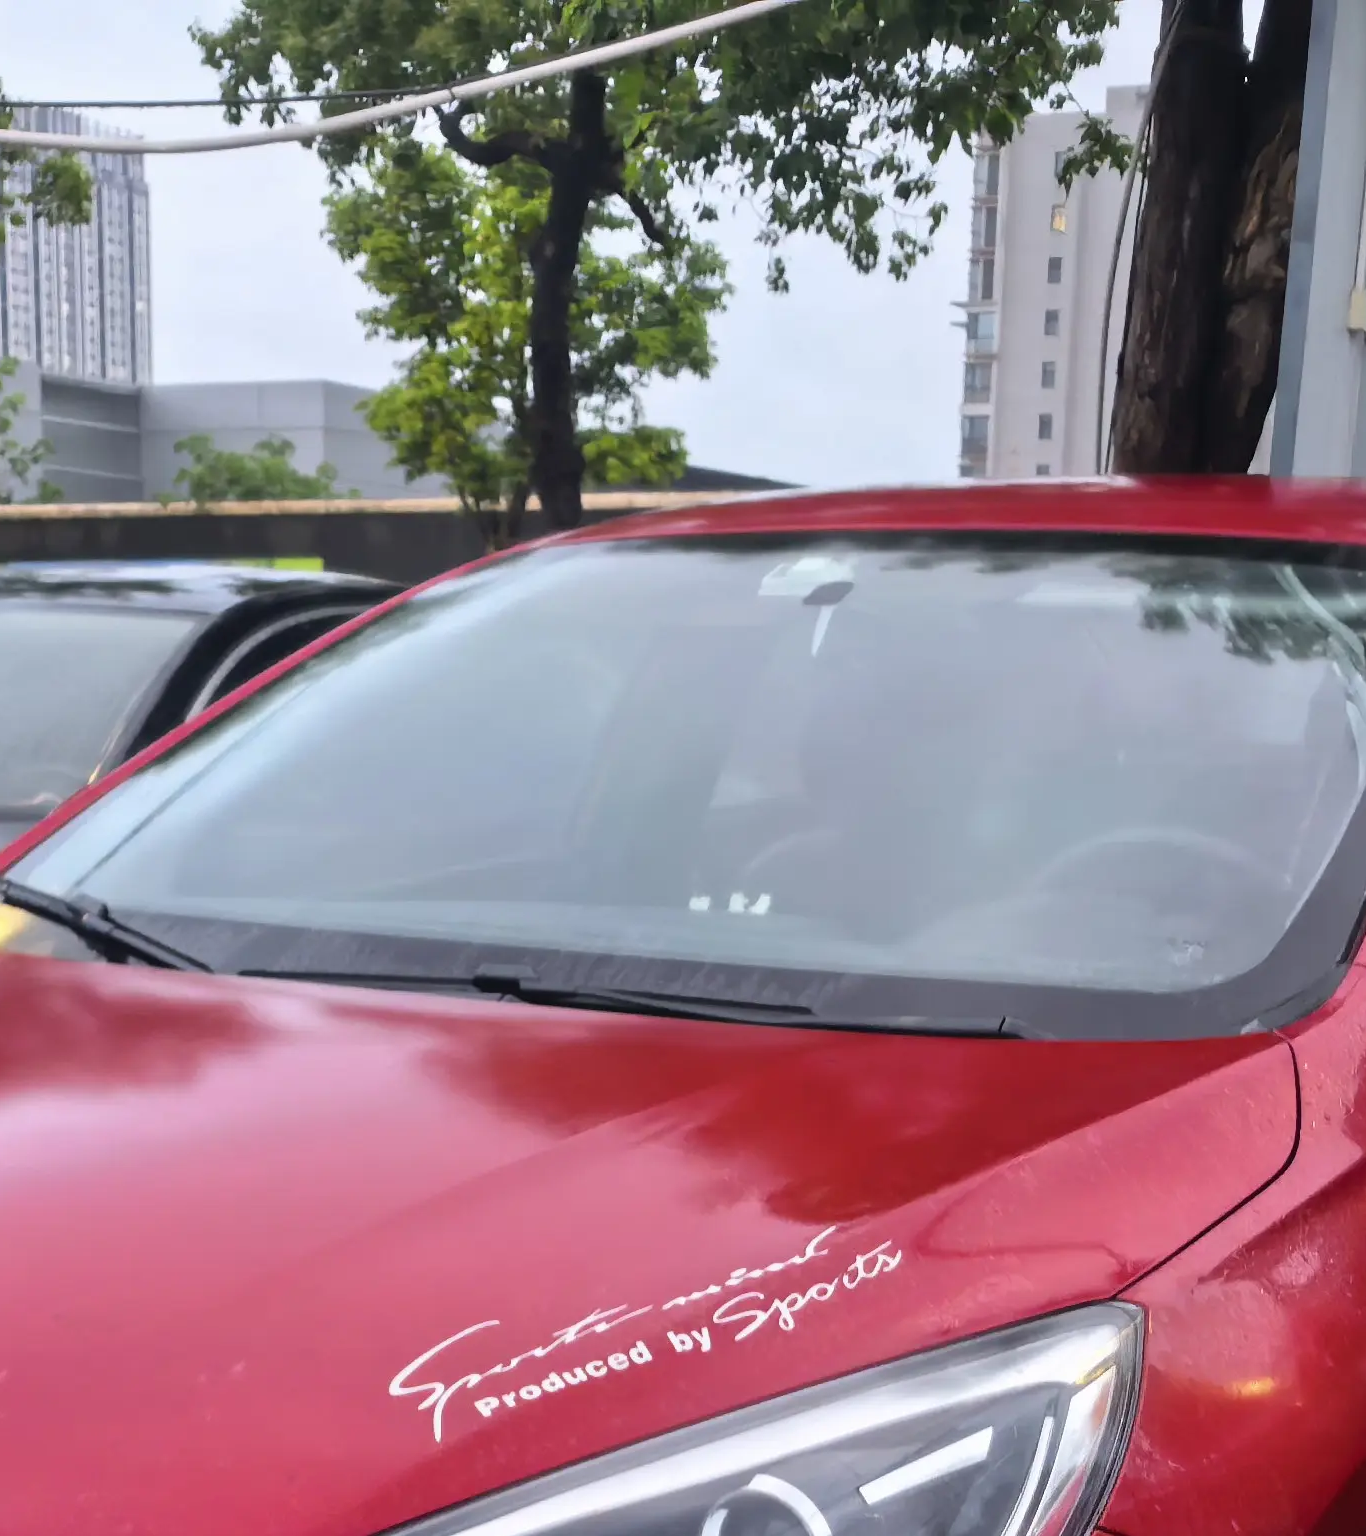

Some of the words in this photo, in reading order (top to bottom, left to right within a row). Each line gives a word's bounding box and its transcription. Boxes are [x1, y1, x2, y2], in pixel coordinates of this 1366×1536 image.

[473, 1341, 653, 1417] Produced
[666, 1324, 713, 1354] by
[712, 1239, 902, 1342] Sports
